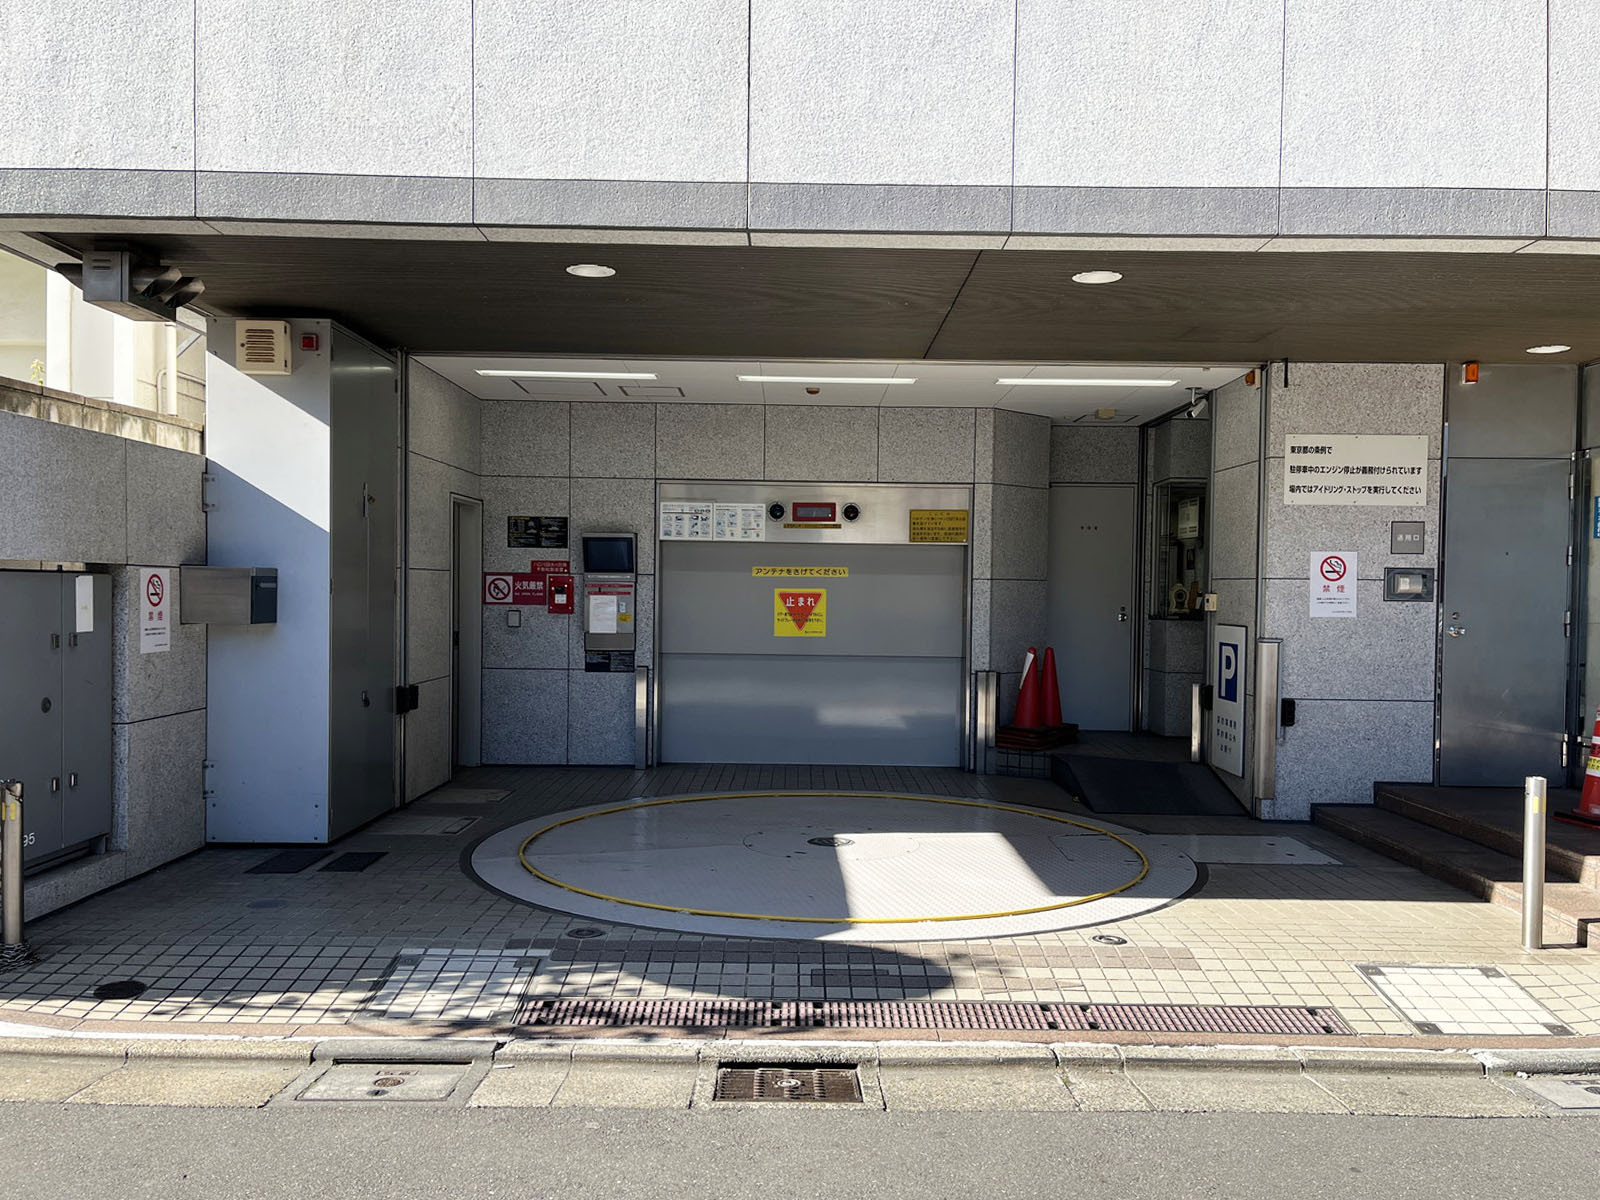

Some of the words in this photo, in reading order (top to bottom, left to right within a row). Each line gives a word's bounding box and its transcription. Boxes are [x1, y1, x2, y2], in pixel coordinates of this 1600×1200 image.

[1290, 446, 1332, 455] 東京都の条例で
[1290, 465, 1422, 475] 駐停車中のエンジン停止が義務付けられています
[1289, 485, 1422, 495] 場内ではアイドリング・ストップを実行してください
[755, 567, 846, 576] アンテナをさげてください
[1322, 584, 1345, 593] 禁煙
[786, 596, 815, 607] 止まれ
[1221, 645, 1236, 697] P
